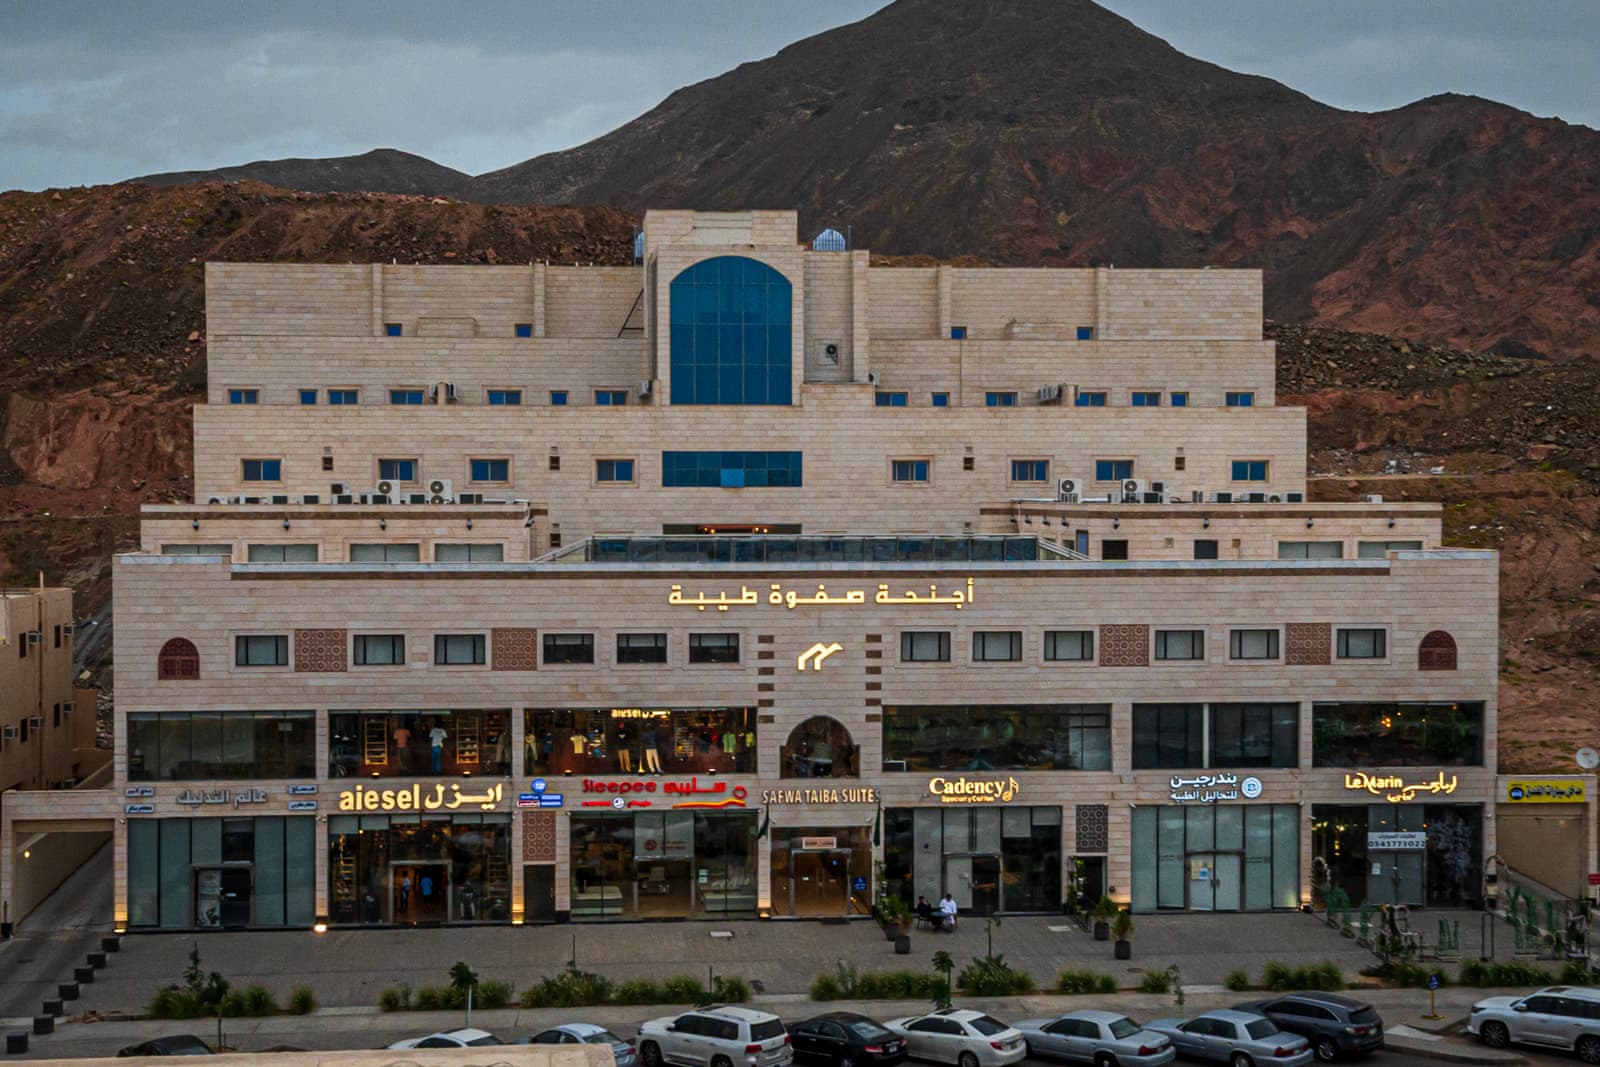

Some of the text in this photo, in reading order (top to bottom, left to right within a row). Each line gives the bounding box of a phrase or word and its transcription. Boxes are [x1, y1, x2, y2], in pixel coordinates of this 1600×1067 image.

[668, 577, 975, 611] أجنحة صفوة طيبة
[582, 778, 657, 794] Sleepee
[929, 777, 1005, 798] Cadency
[1170, 772, 1237, 788] بندرجين
[176, 789, 229, 808] التدليك
[233, 789, 268, 809] عالم
[338, 783, 421, 811] aiesel
[424, 783, 504, 810] ايزل
[762, 788, 881, 804] SAFWA TAIBA SUITES
[1170, 789, 1238, 803] للتحاليل الطبية
